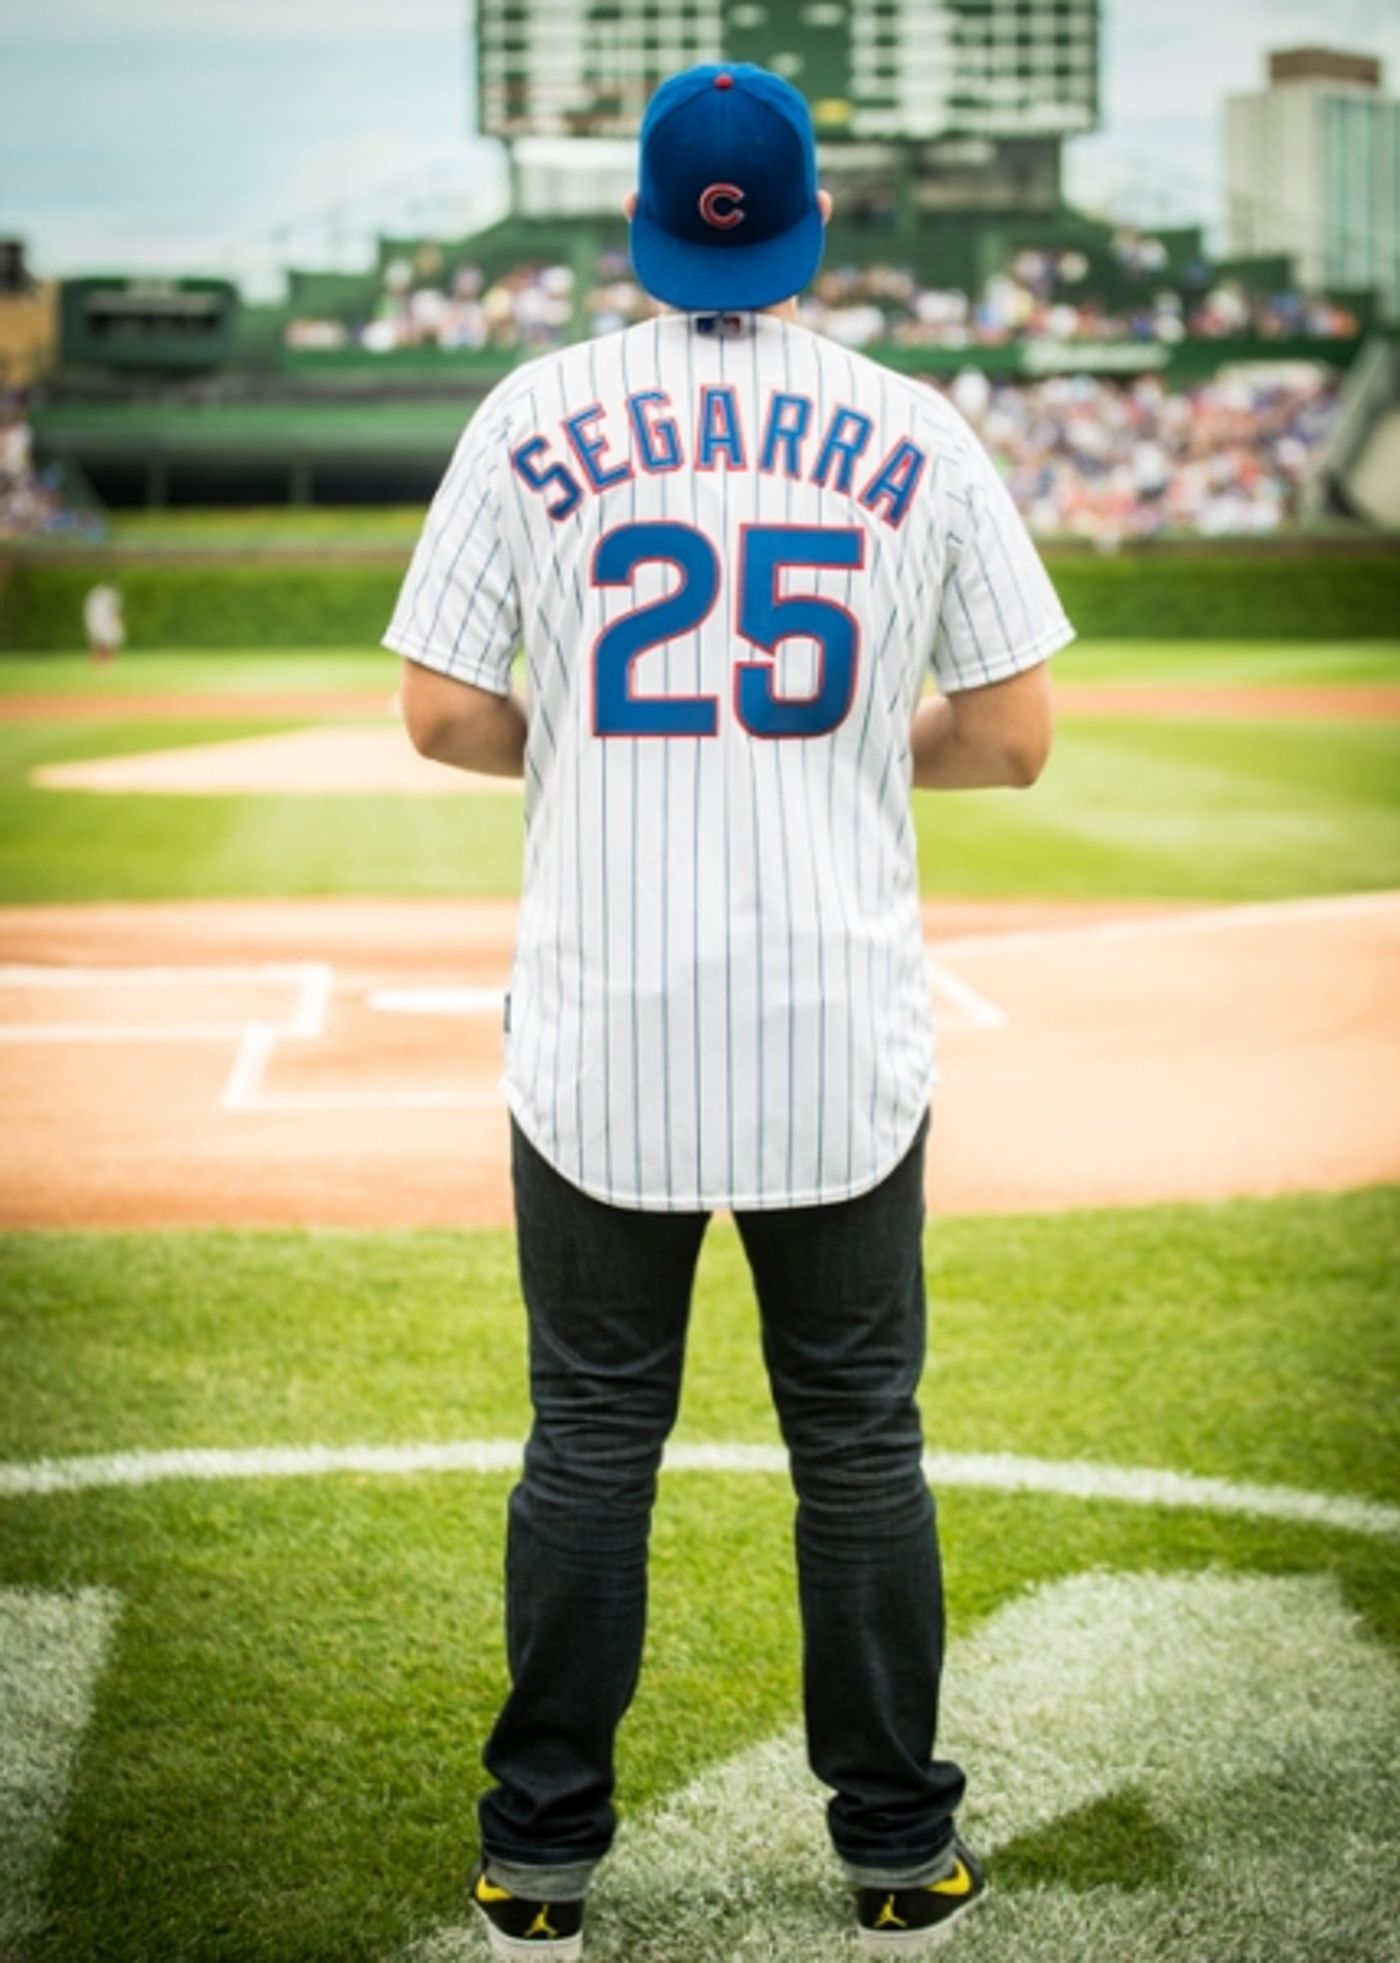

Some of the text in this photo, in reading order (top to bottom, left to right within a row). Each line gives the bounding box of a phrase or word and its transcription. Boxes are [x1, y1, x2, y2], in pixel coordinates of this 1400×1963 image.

[698, 182, 746, 229] C
[510, 384, 927, 530] SEGARRA
[590, 520, 866, 741] 25
